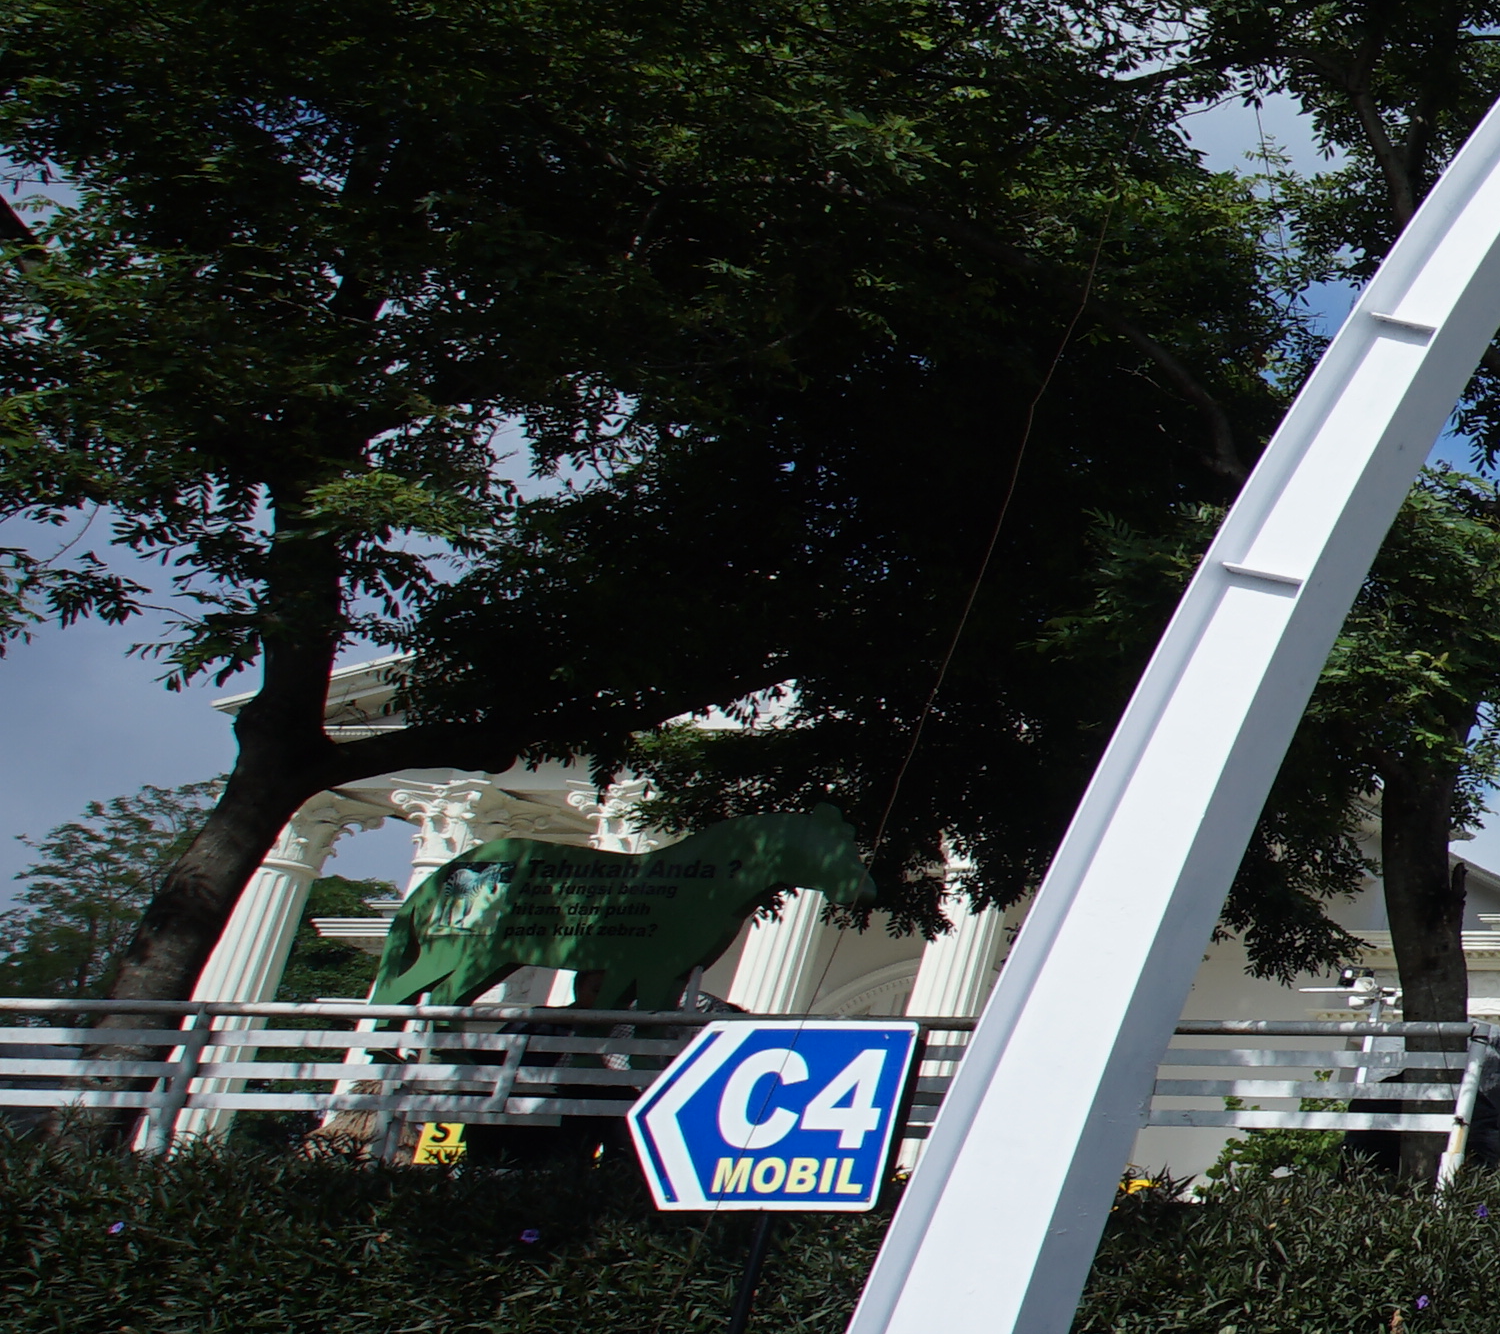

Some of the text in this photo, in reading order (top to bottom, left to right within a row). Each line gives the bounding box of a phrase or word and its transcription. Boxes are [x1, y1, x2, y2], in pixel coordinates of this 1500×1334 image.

[527, 859, 743, 879] Tahukah Anda ?
[519, 882, 677, 898] Apa fungsi belang
[511, 902, 650, 918] hitam dan putih
[504, 923, 658, 939] pada kulit zebra?
[717, 1048, 888, 1150] C4
[710, 1157, 863, 1194] MOBIL
